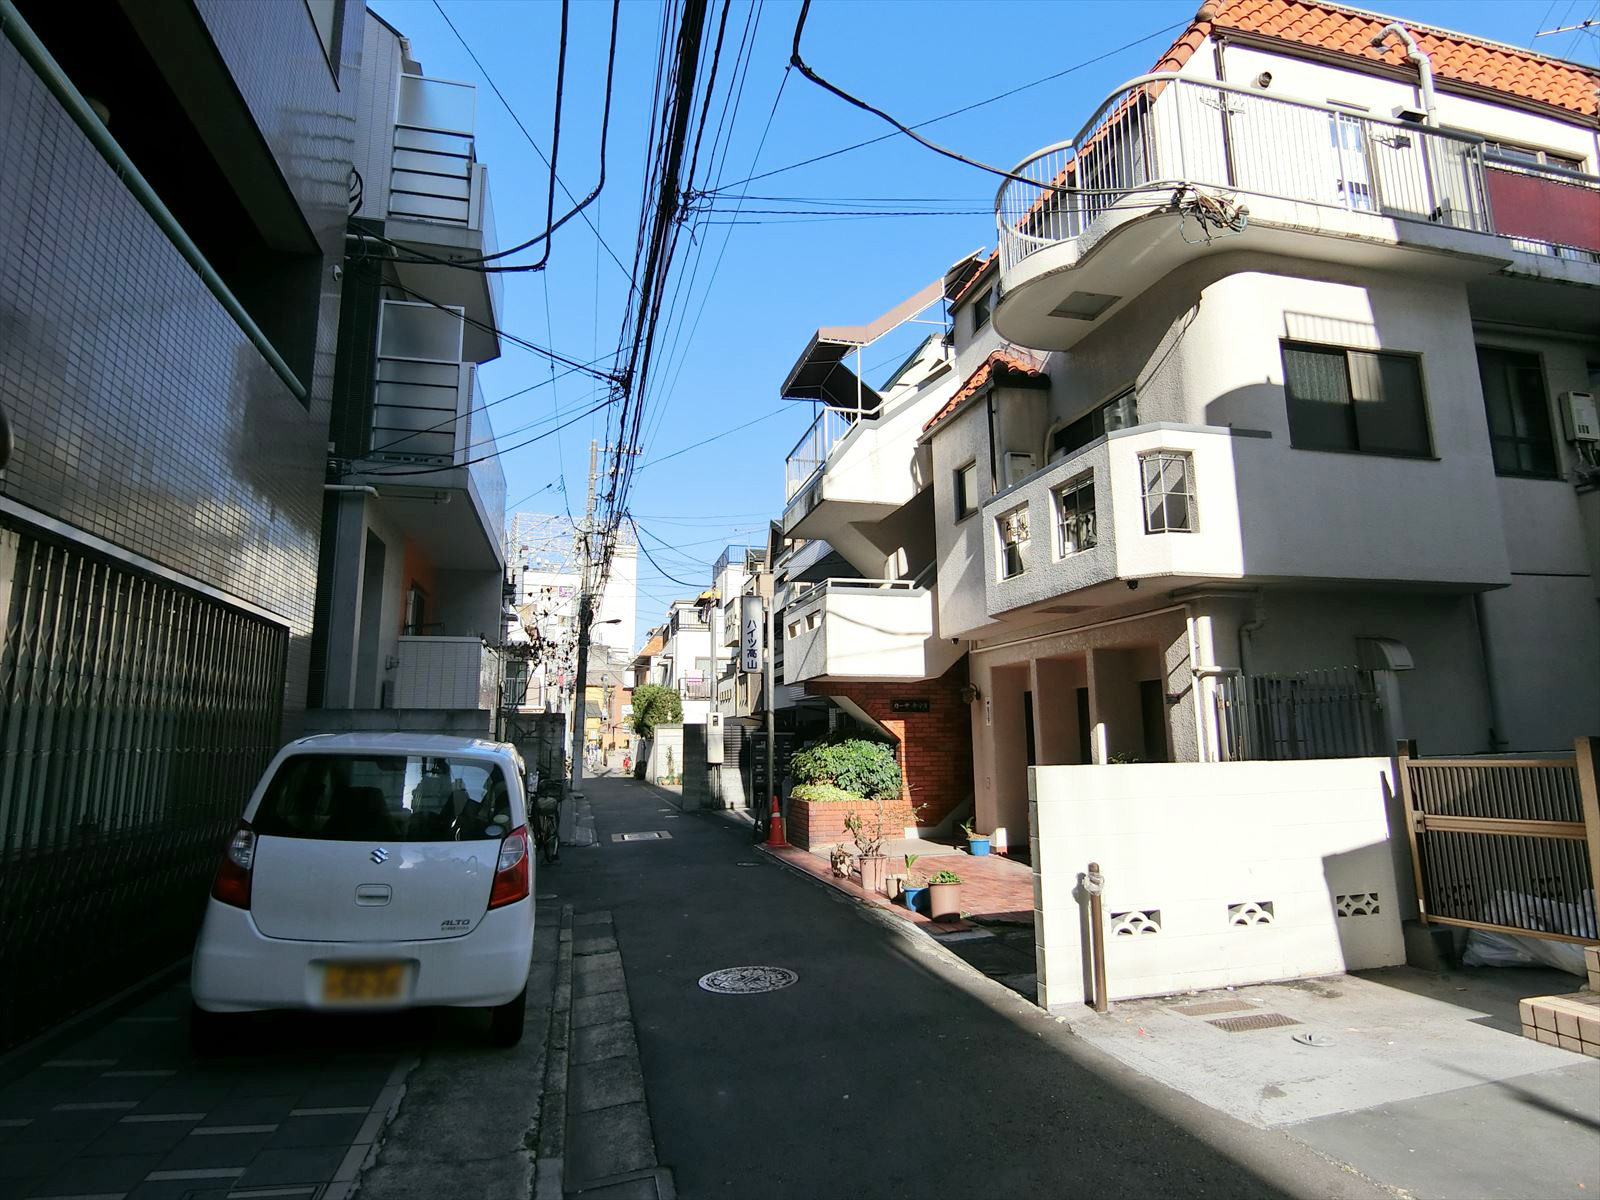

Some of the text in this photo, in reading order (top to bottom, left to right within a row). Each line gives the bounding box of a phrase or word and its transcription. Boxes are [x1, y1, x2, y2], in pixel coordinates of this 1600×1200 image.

[746, 619, 758, 670] ハイツ高山
